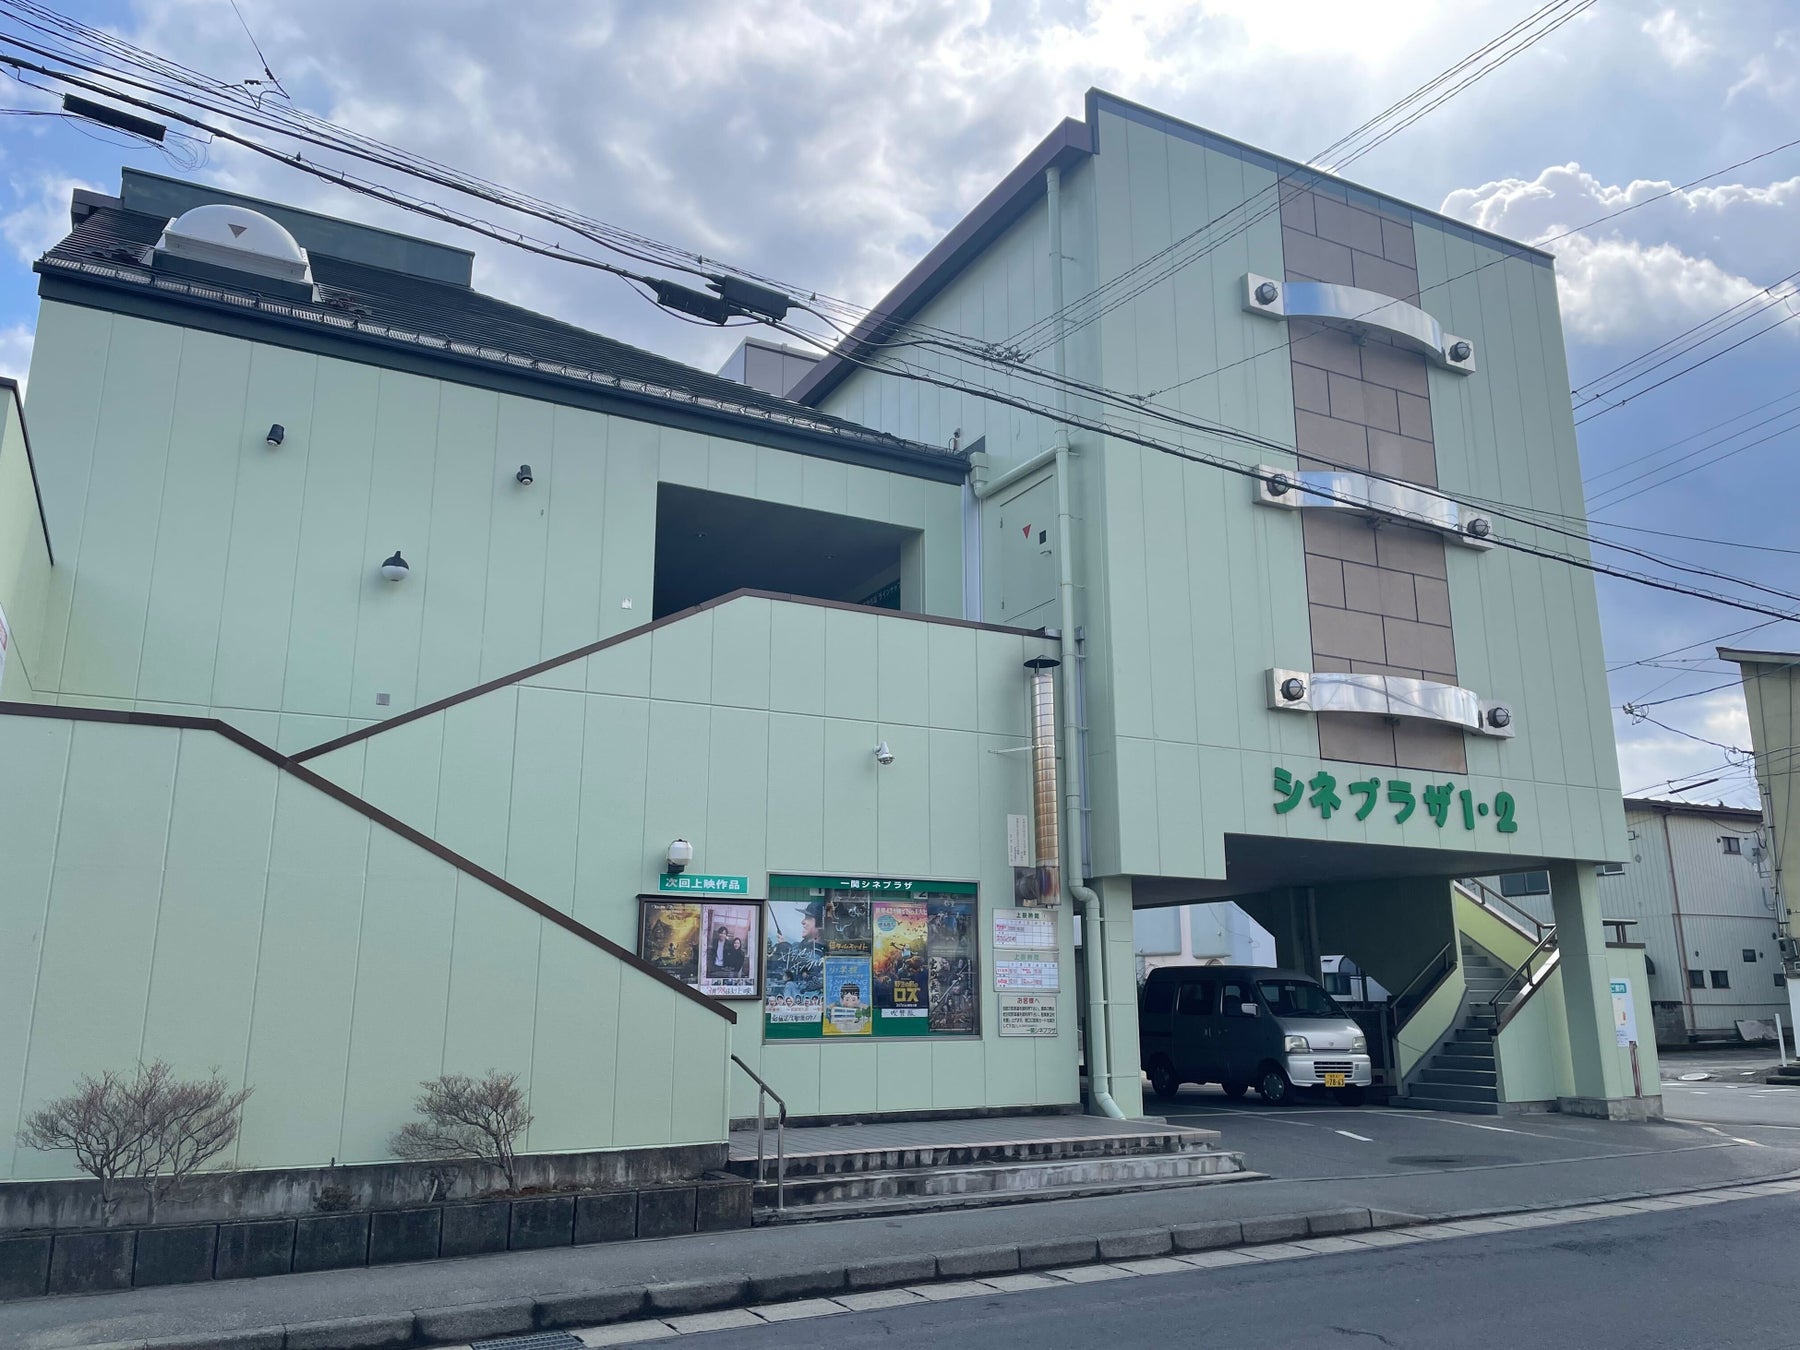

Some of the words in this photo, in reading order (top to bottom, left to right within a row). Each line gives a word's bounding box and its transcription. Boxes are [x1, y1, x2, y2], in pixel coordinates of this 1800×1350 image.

[665, 877, 740, 890] 次回上映作品
[840, 879, 913, 890] 一関シネプラザ
[894, 987, 920, 1002] ロズ
